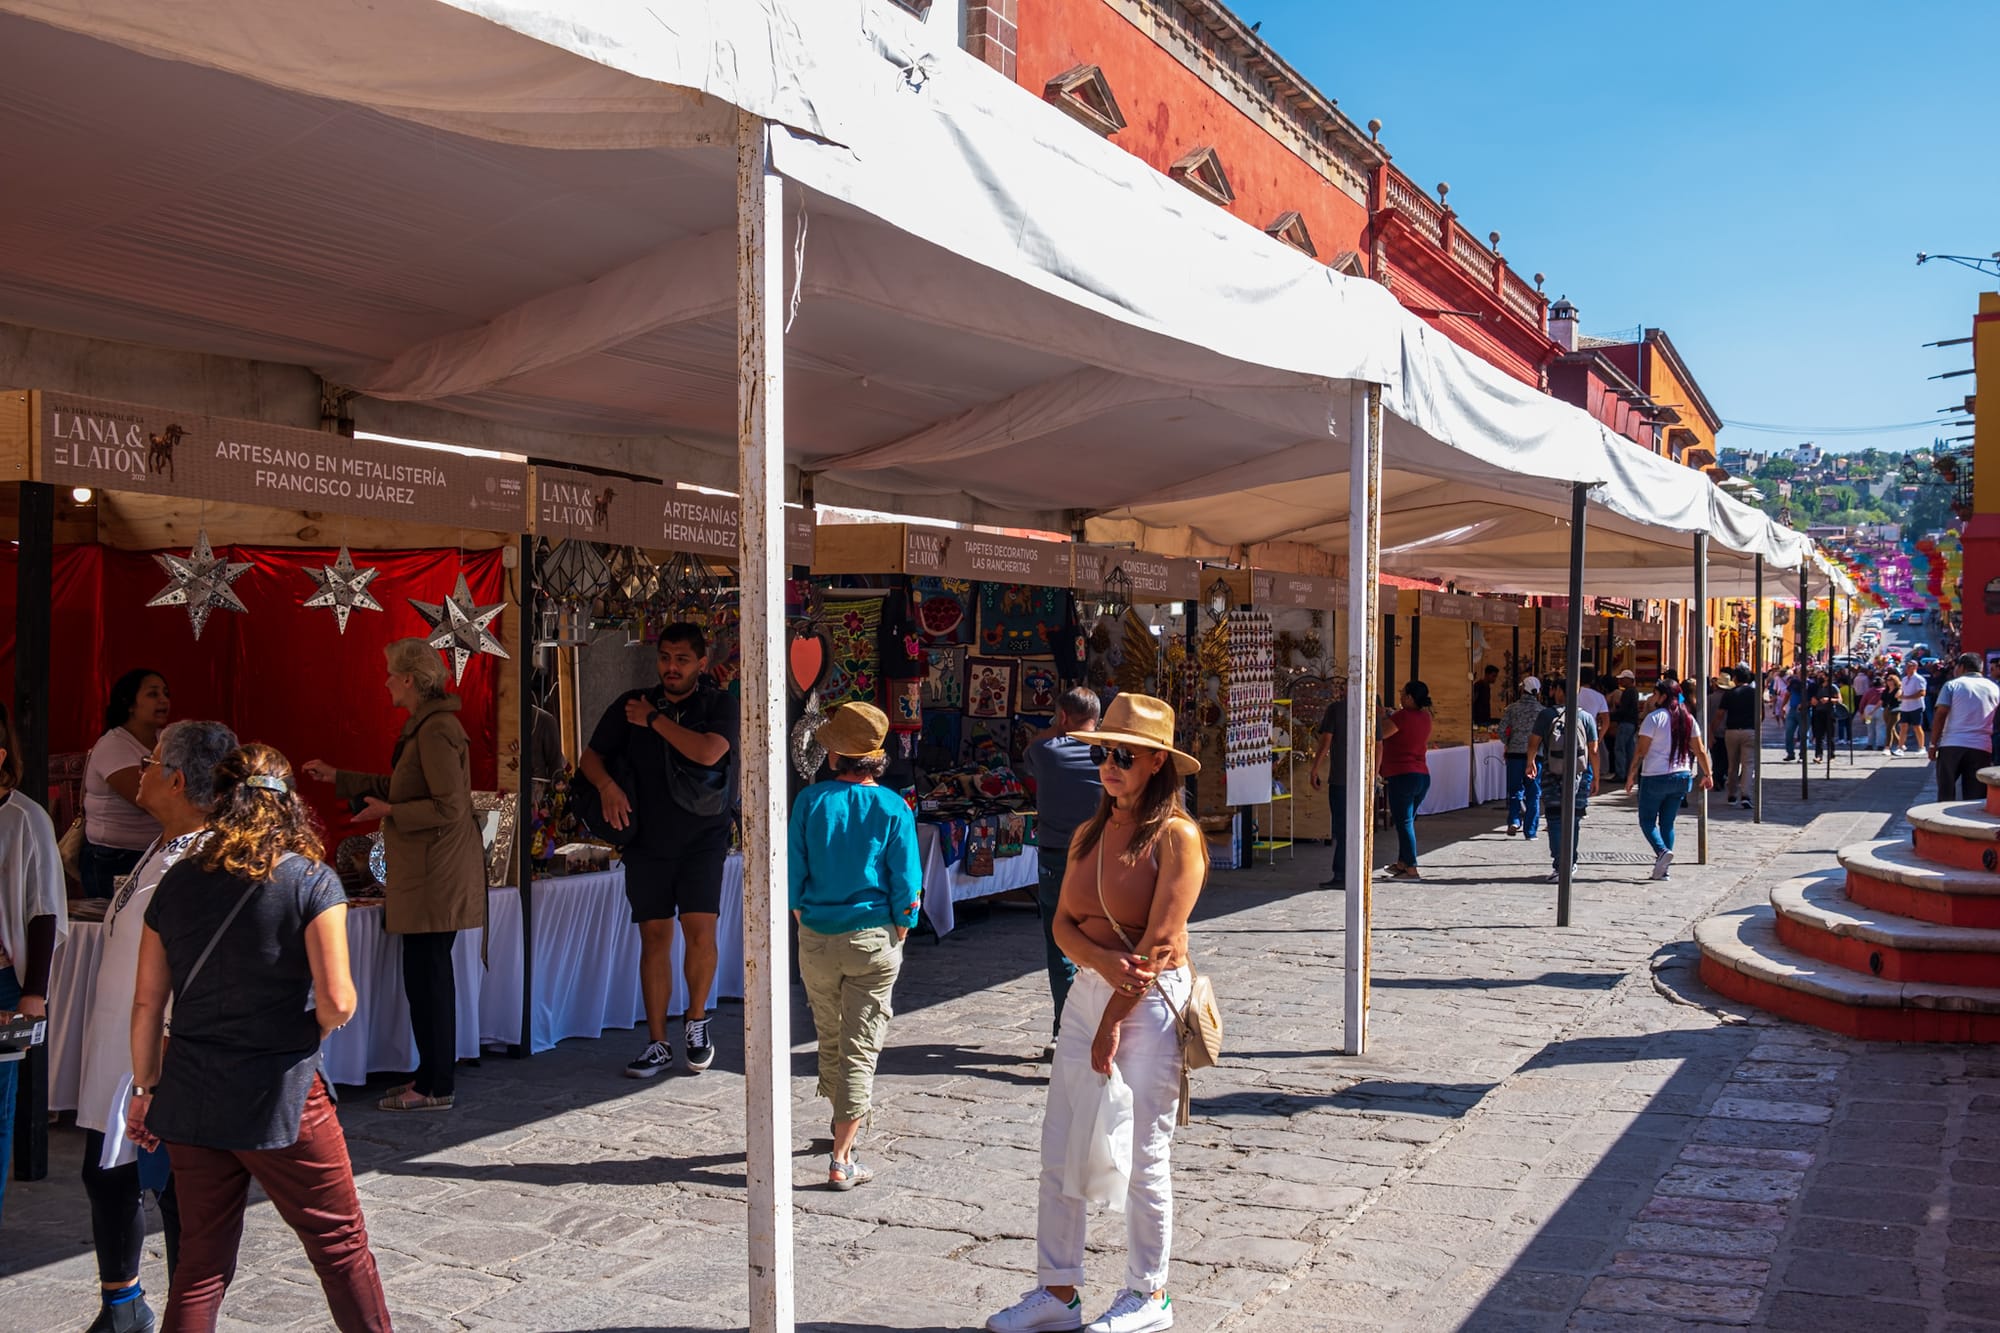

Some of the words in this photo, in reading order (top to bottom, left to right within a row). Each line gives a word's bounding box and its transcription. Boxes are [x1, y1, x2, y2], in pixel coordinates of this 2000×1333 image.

[53, 413, 120, 445] LANA
[126, 424, 145, 448] &
[73, 443, 146, 473] LATÓN
[215, 441, 310, 469] ARTESANO
[316, 454, 337, 473] EN
[342, 457, 447, 487] METALISTERÍA
[131, 473, 146, 481] 2022
[256, 469, 351, 497] FRANCISCO
[356, 481, 415, 504] JUÁREZ
[543, 482, 579, 505] LANA
[581, 488, 592, 507] &
[552, 503, 593, 526] LATÓN
[663, 500, 738, 527] ARTESANÍAS
[663, 522, 737, 548] HERNÁNDEZ
[909, 534, 930, 550] LANA
[964, 541, 993, 556] TAPETES
[994, 544, 1038, 561] DECORATIVOS
[972, 556, 985, 569] LAS
[986, 558, 1031, 574] RANCHERITAS
[1122, 559, 1168, 577] CONSTELACIÓN
[1134, 576, 1167, 592] ESTRELLAS
